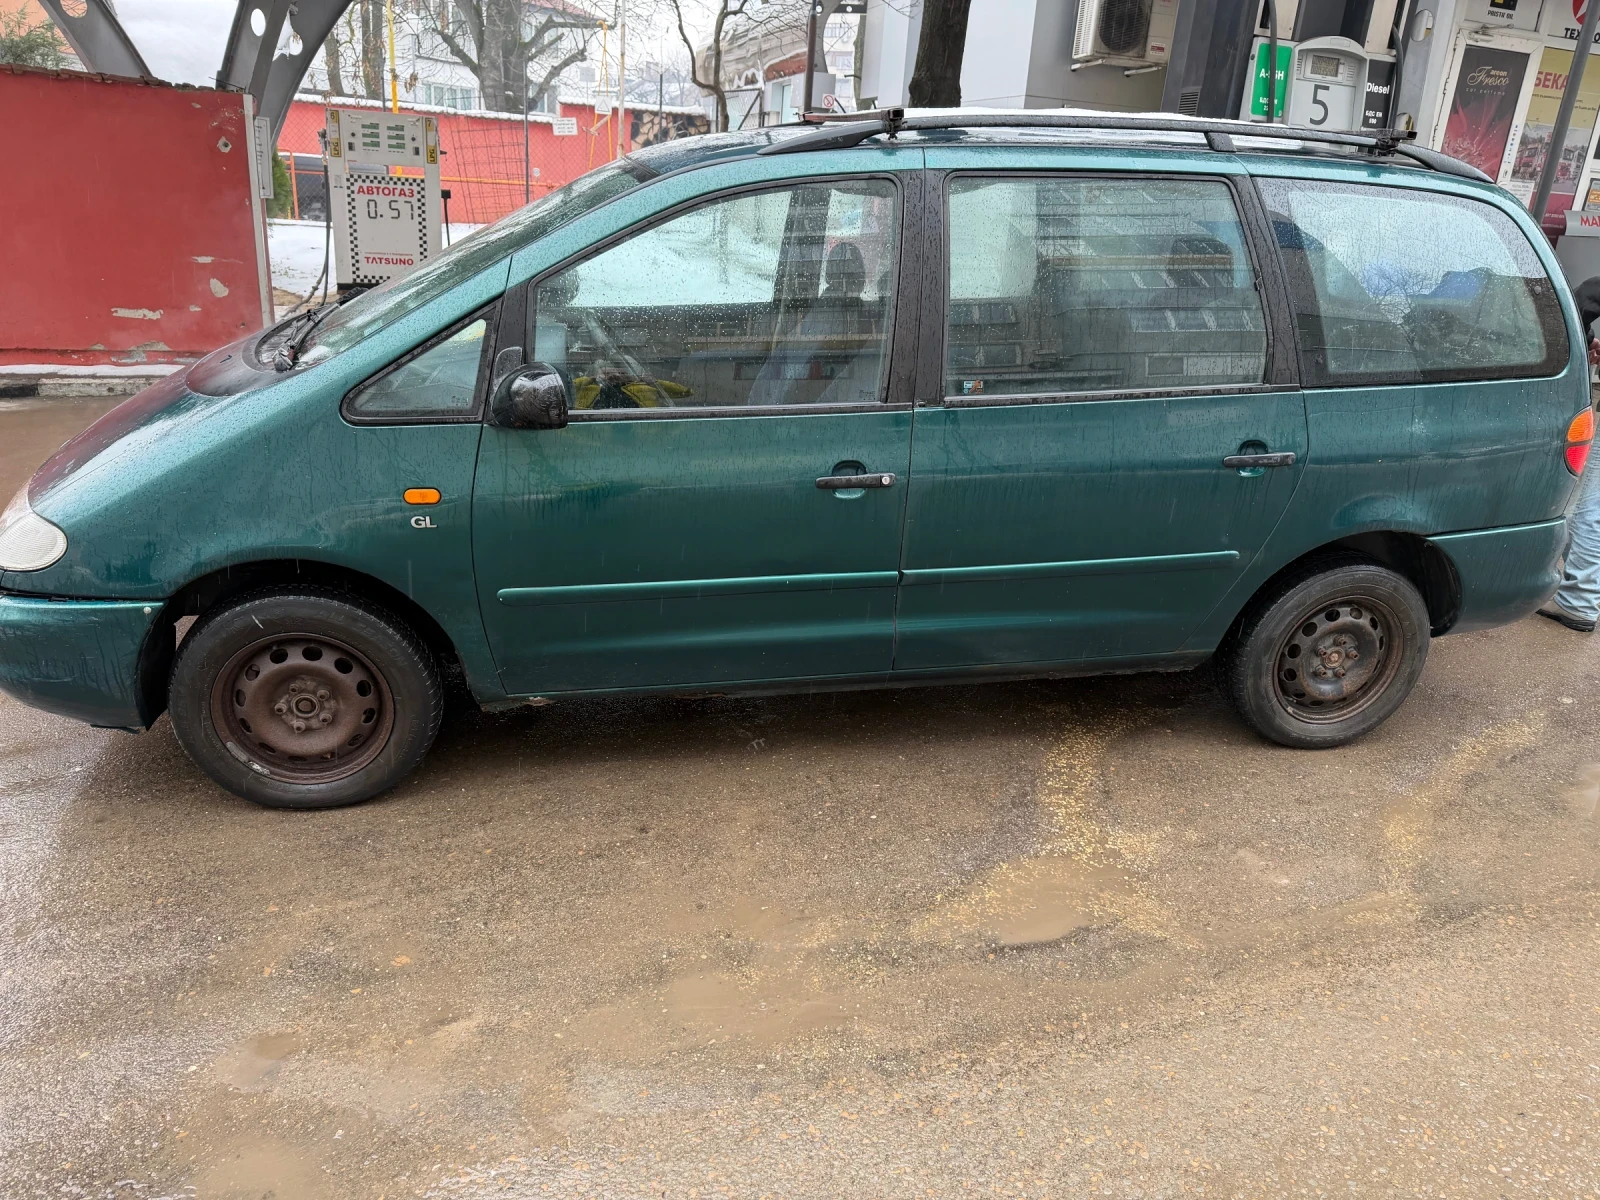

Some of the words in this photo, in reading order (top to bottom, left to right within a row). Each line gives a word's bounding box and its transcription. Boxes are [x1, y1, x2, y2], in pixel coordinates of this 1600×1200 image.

[1467, 66, 1510, 86] Fresco
[1490, 69, 1508, 77] areon
[1366, 82, 1390, 95] Diesel
[1309, 83, 1330, 126] 5
[330, 111, 336, 120] 6
[427, 119, 432, 127] 7
[332, 141, 340, 156] LPG
[357, 185, 414, 198] АВТОГАЗ
[367, 199, 414, 220] 0.57
[364, 256, 414, 266] TATSUNO
[410, 515, 438, 529] GL
